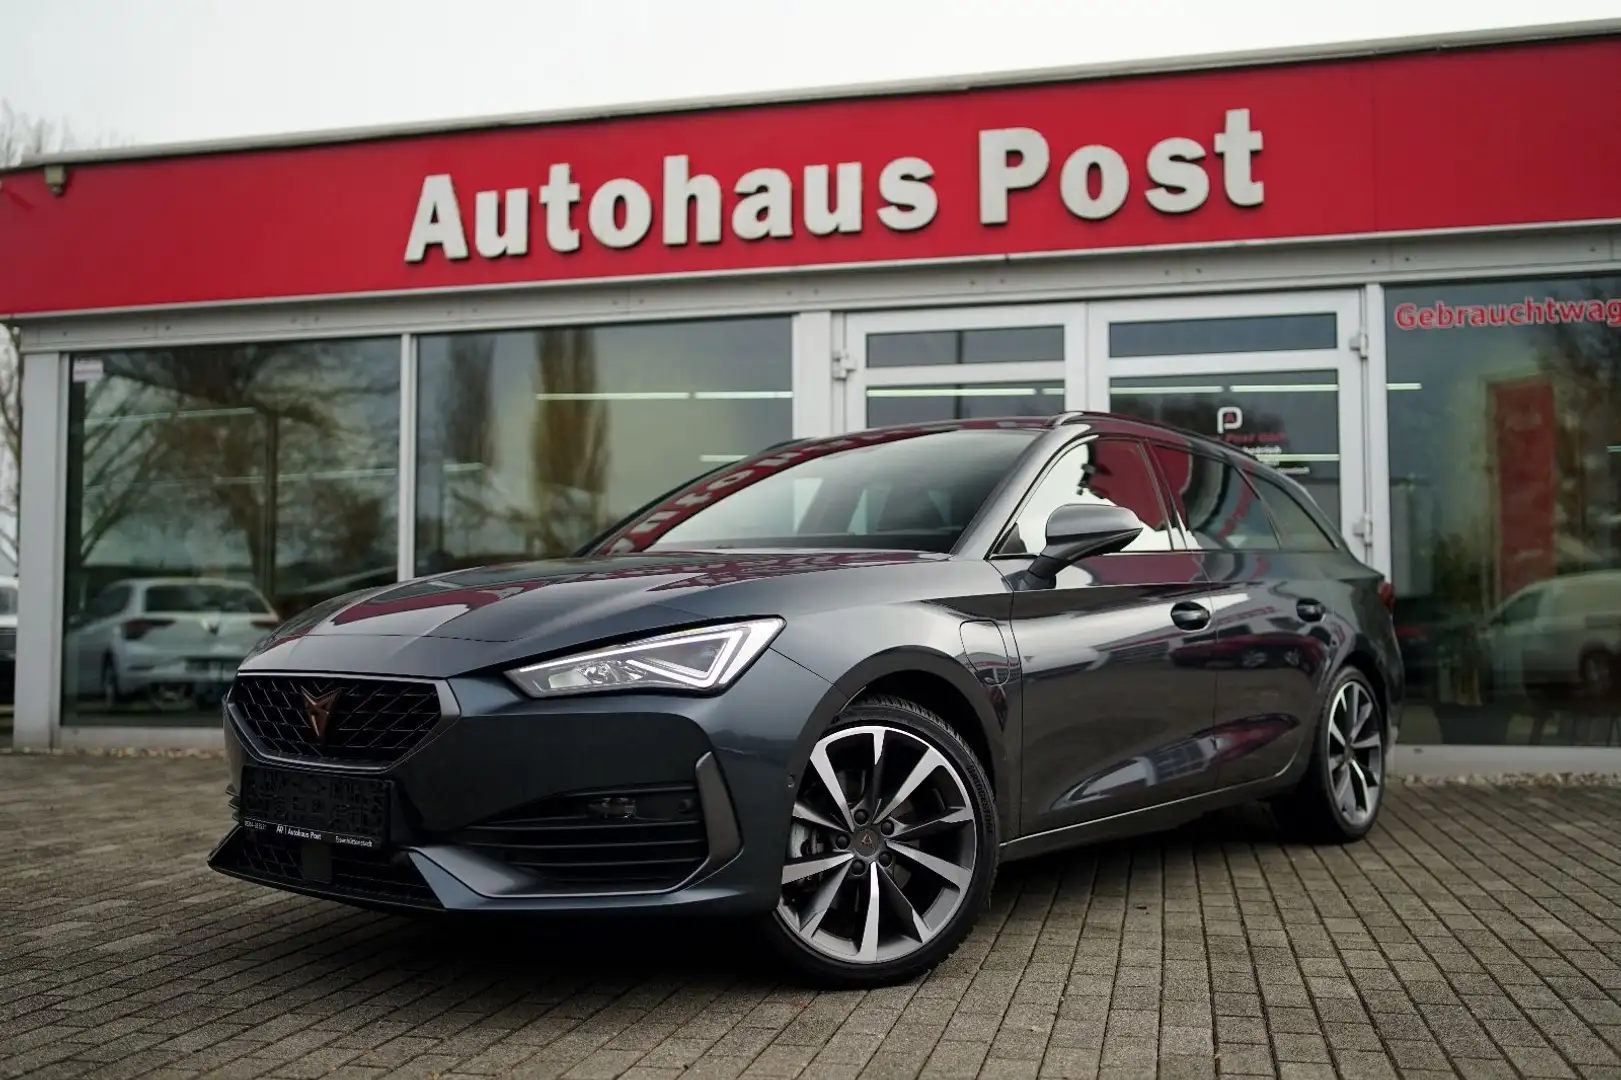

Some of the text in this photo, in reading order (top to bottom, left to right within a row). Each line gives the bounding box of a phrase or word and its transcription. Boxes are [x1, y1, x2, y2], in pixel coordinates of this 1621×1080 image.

[403, 108, 1265, 263] Autohaus Post
[1394, 296, 1621, 331] Gebrauchtwag
